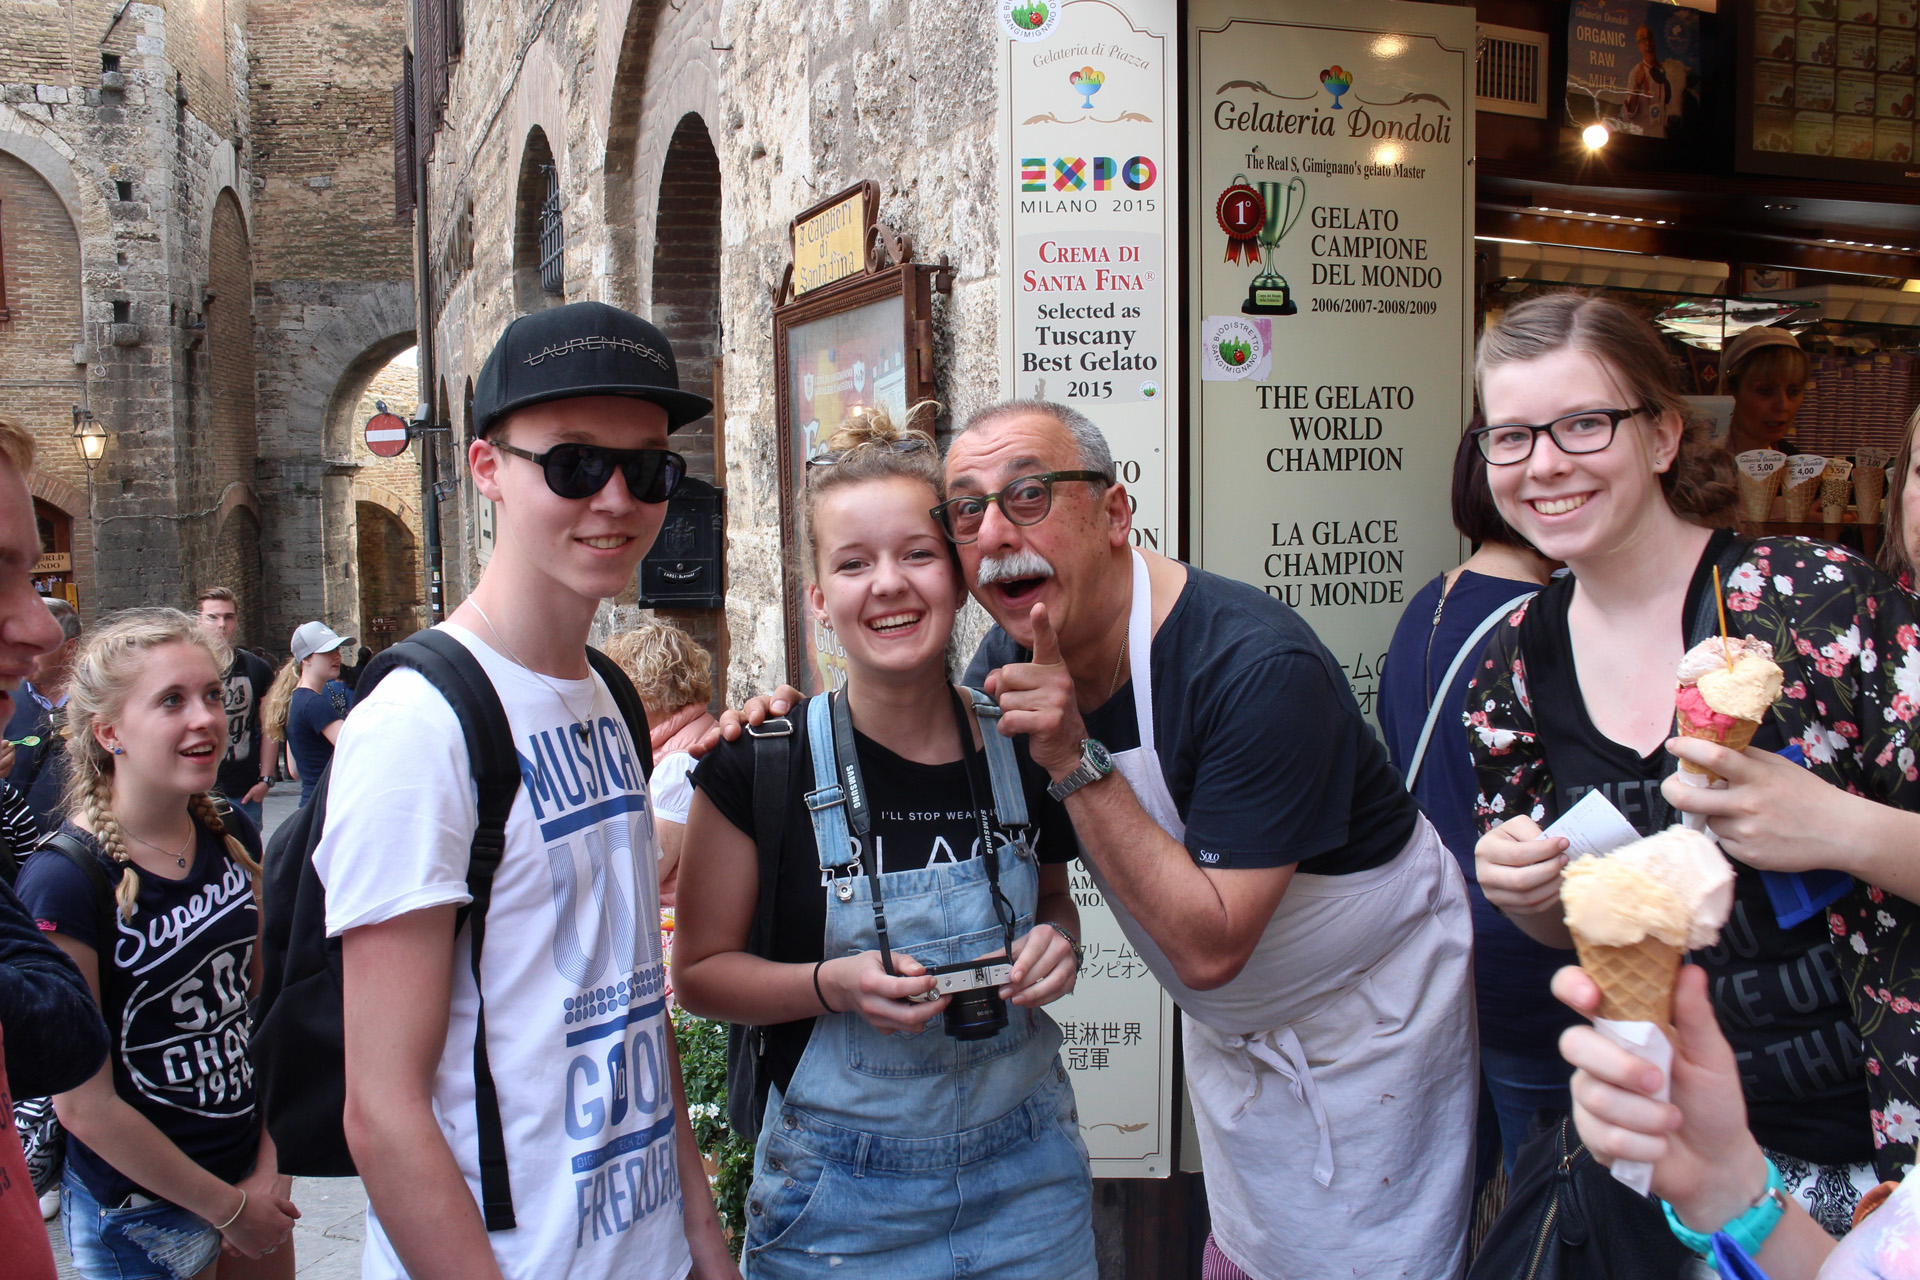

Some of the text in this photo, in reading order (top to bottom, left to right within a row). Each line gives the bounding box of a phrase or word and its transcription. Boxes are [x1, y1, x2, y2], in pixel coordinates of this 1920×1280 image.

[1576, 25, 1626, 48] ORGANIC
[1033, 43, 1150, 70] Gelateria di Piazza
[1589, 50, 1615, 68] RAW
[1588, 73, 1617, 90] MILK
[1214, 101, 1451, 143] Gelateria Dondoli
[1021, 155, 1157, 192] EXPO
[1245, 153, 1264, 170] The
[1267, 155, 1288, 171] Real
[1302, 157, 1361, 177] Gimignano's
[1363, 163, 1391, 180] gelato
[1392, 162, 1425, 179] Master
[1021, 200, 1155, 213] MILANO 2015
[1311, 206, 1398, 231] GELATO
[1311, 235, 1428, 260] CAMPIONE
[800, 264, 827, 292] Santa
[1311, 263, 1442, 288] DEL MONDO
[1038, 302, 1141, 319] Selected as
[1311, 298, 1437, 315] 2006/2007-2008/2009
[1035, 326, 1136, 350] Tuscany
[1213, 322, 1260, 352] BIODISTRETTO
[1022, 350, 1158, 372] Best Gelato
[1211, 344, 1258, 374] SANGIMIGNANO
[1067, 381, 1113, 399] 2015
[1255, 385, 1414, 410] THE GELATO
[1289, 416, 1382, 440] WORLD
[1266, 447, 1404, 472] CHAMPION
[1757, 463, 1774, 472] 5,00
[1797, 467, 1814, 475] 4,00
[1271, 520, 1398, 546] LA GLACE
[1264, 550, 1404, 578] CHAMPION
[1264, 580, 1404, 608] DU MONDE
[846, 764, 861, 809] SAMSUNG
[881, 811, 903, 820] I'LL
[908, 812, 941, 821] STOP
[980, 809, 993, 855] SAMSUNG
[1778, 943, 1842, 1013] UP
[1068, 1048, 1110, 1070] 冠軍
[1765, 1020, 1867, 1101] THA
[195, 1057, 254, 1107] 1954
